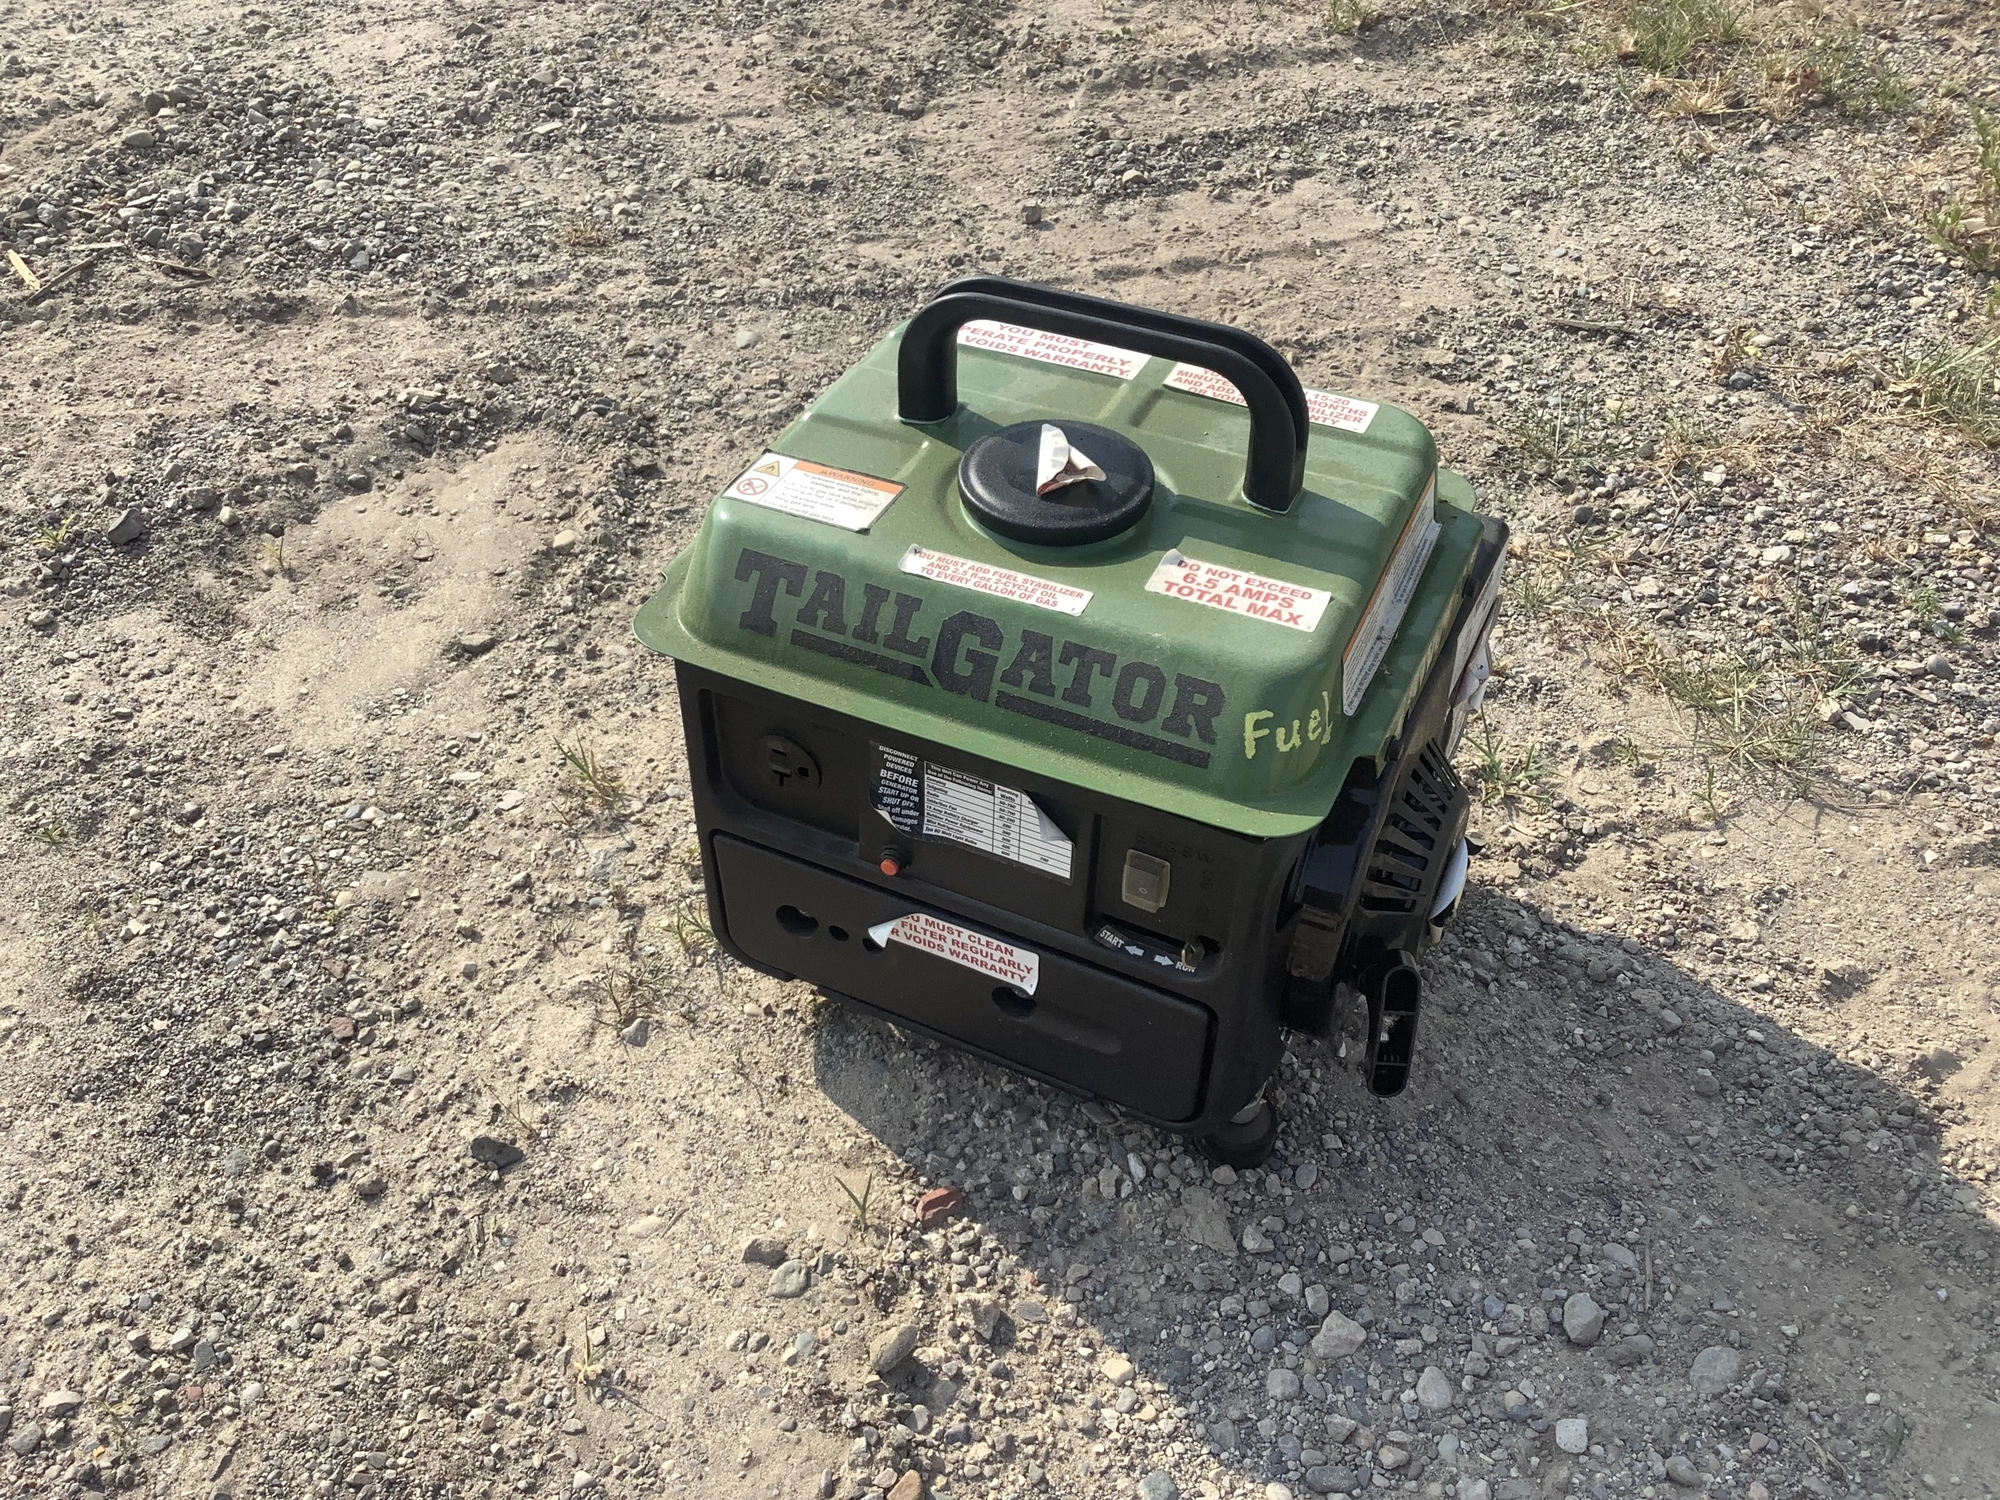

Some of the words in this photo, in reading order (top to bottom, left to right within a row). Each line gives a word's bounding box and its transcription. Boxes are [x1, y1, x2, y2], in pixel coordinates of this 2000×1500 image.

[960, 325, 1031, 345] PERATE
[1034, 341, 1132, 367] PROPERLY
[999, 323, 1034, 337] YOU
[1040, 333, 1093, 349] MUST
[965, 336, 1018, 353] VOIDS
[1024, 348, 1131, 377] WARRANTY.
[1177, 370, 1235, 388] MINUTE
[1173, 377, 1203, 387] AND
[1206, 384, 1236, 395] ADD
[1308, 406, 1364, 423] BILIZER
[1212, 391, 1246, 404] VOID
[1314, 393, 1350, 406] 15-20
[826, 470, 875, 487] WARNING
[912, 549, 935, 561] YOU
[936, 556, 967, 569] MUST
[968, 564, 990, 575] ADD
[992, 569, 1019, 583] FUEL
[1022, 577, 1085, 600] STABILIZER
[927, 561, 949, 572] AND
[951, 567, 968, 577] 2.5
[993, 578, 1038, 595] 2-CYCLE
[1040, 588, 1058, 600] OIL
[1177, 559, 1201, 572] DO
[1205, 567, 1242, 582] NOT
[1244, 577, 1313, 600] EXCEED
[920, 566, 935, 576] TO
[936, 570, 973, 585] EVERY
[973, 580, 1015, 597] GALLON
[1018, 591, 1034, 601] OF
[1035, 595, 1058, 608] GAS
[1182, 572, 1220, 590] 6.5
[1223, 583, 1295, 609] AMPS
[1163, 580, 1238, 610] TOTAL
[1245, 602, 1304, 626] MAX
[735, 547, 1227, 745] TAILGATOR
[1242, 690, 1333, 760] Fuel
[878, 745, 918, 762] DISCONNECT
[883, 753, 915, 768] POWERED
[880, 768, 919, 788] BEFORE
[886, 761, 913, 775] DEVICES
[881, 779, 918, 795] GENERATOR
[926, 776, 947, 787] Camping
[926, 783, 949, 795] Tailgating
[952, 777, 977, 790] Following
[878, 786, 900, 796] START
[900, 790, 910, 799] UP
[910, 795, 920, 803] OR
[882, 796, 902, 805] SHUT
[926, 790, 940, 798] Radio
[901, 808, 920, 817] under
[926, 811, 944, 821] Outdoor
[944, 817, 959, 826] Power
[959, 822, 984, 834] Equipment
[943, 810, 960, 820] Battery
[960, 816, 979, 825] Charger
[900, 921, 948, 944] FILTER
[951, 938, 1034, 975] REGULARLY
[924, 918, 964, 939] MUST
[967, 934, 1015, 958] CLEAN
[1099, 929, 1125, 949] START
[903, 931, 946, 953] VOIDS
[949, 947, 1028, 983] WARRANTY
